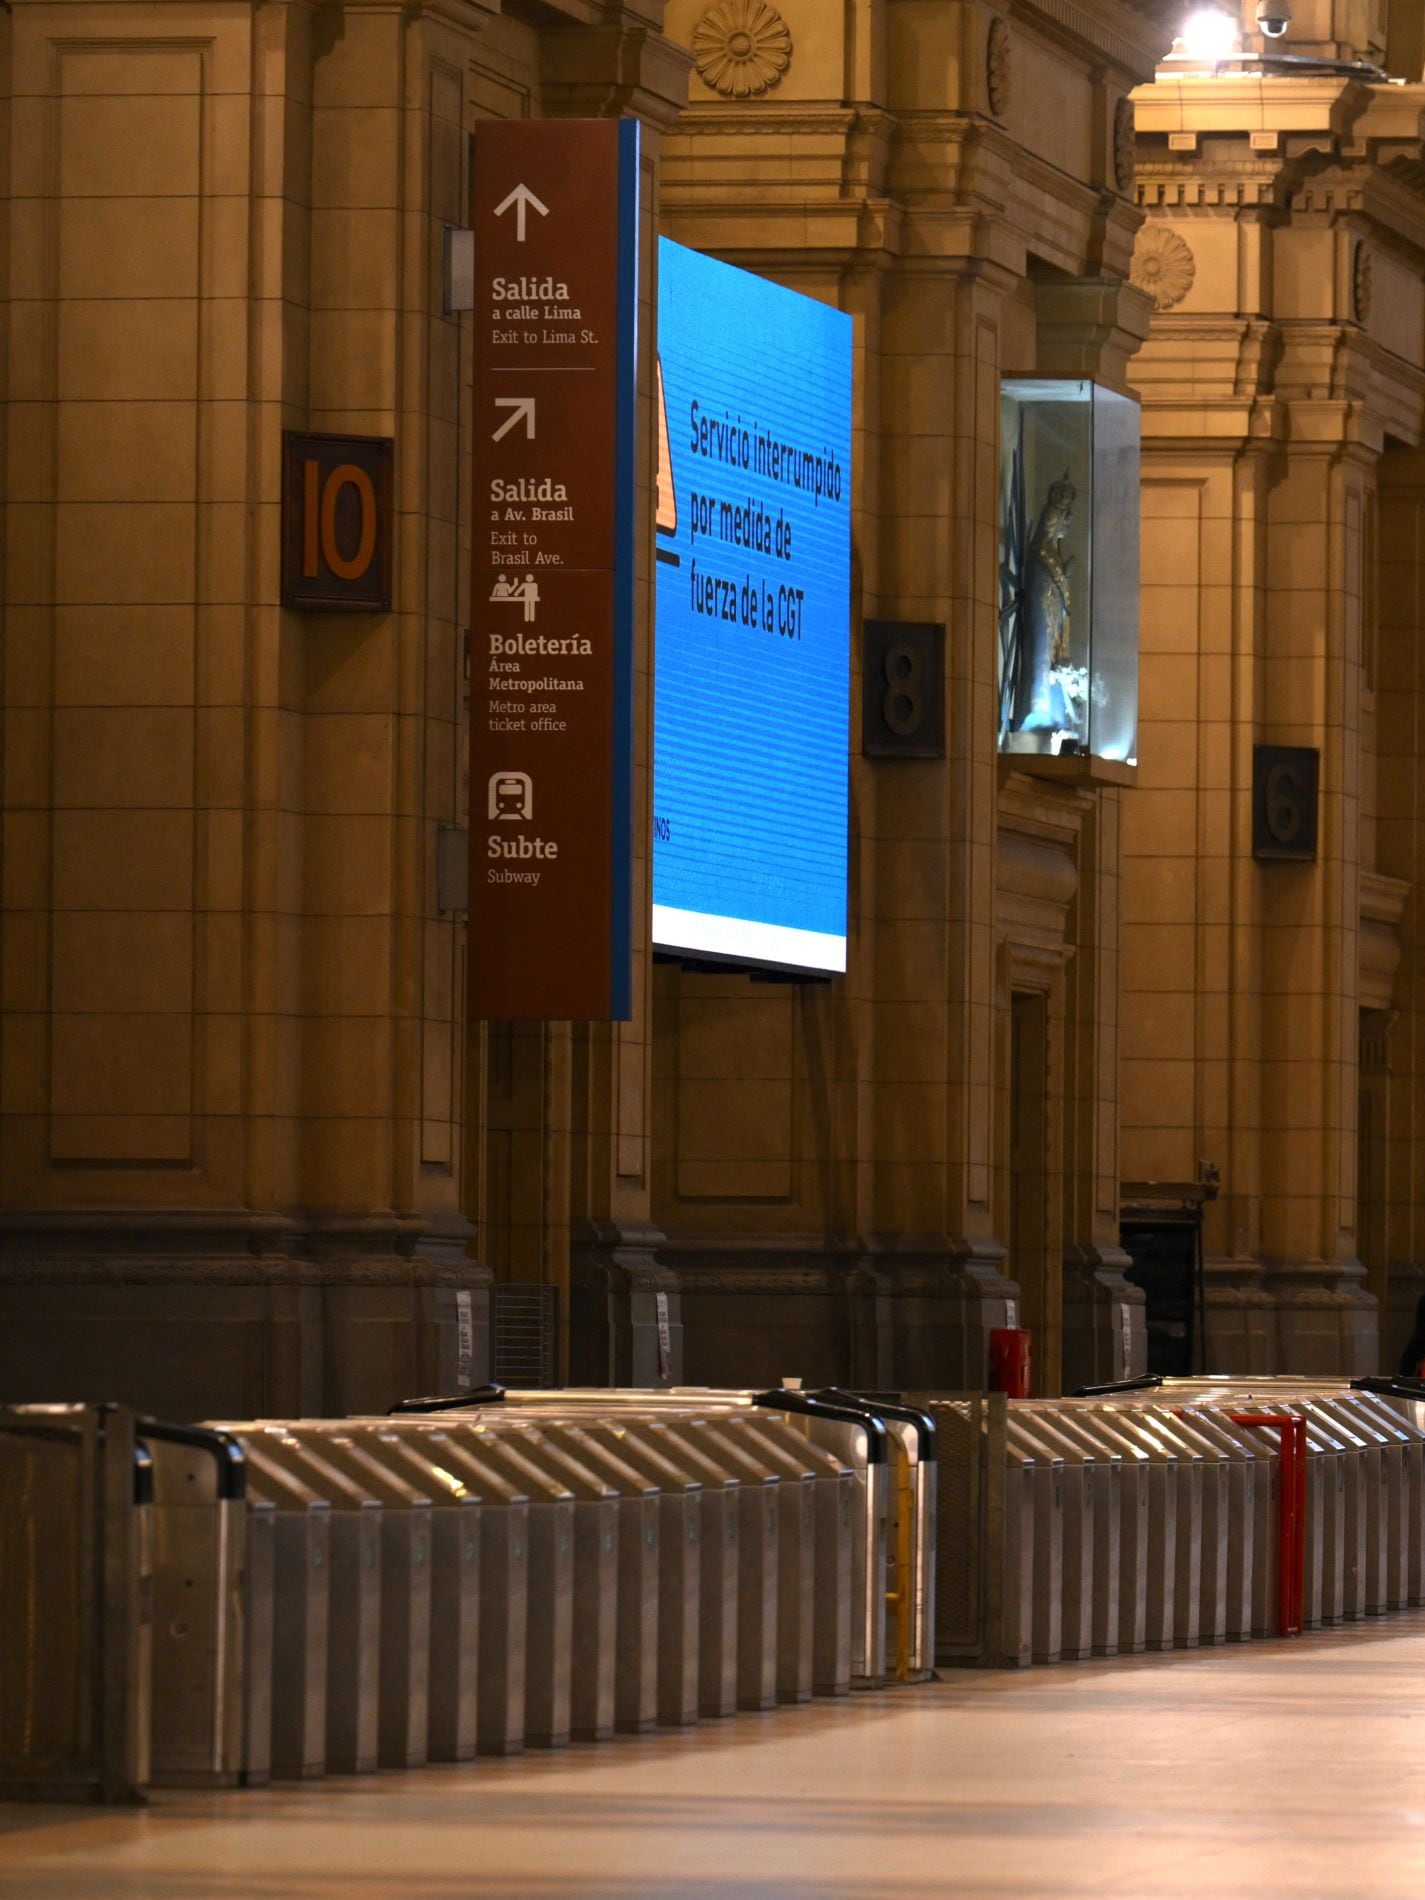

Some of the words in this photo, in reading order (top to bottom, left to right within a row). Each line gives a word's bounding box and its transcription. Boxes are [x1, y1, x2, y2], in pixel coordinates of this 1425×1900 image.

[492, 277, 570, 301] Salida
[492, 308, 501, 320] a
[505, 305, 539, 320] calle
[543, 305, 582, 320] Lima
[492, 329, 519, 344] Exit
[523, 331, 538, 344] to
[542, 329, 576, 344] Lima
[580, 329, 599, 344] St.
[690, 399, 750, 470] Servicio
[753, 420, 842, 508] interrumpido
[490, 478, 568, 502] Salida
[303, 459, 377, 580] 10
[490, 510, 500, 521] a
[504, 507, 526, 521] Av.
[531, 506, 575, 521] Brasil
[690, 491, 716, 546] por
[719, 496, 772, 556] medida
[775, 507, 792, 561] de
[490, 531, 518, 545] Exit
[523, 532, 538, 545] to
[491, 550, 530, 565] Brasil
[534, 551, 564, 565] Ave.
[690, 557, 737, 624] fuerza
[741, 573, 758, 630] de
[762, 578, 774, 634] la
[778, 583, 805, 641] CGT
[488, 632, 593, 655] Boletería
[488, 656, 521, 673] Área
[488, 677, 584, 694] Metropolitana
[488, 700, 526, 713] Metro
[529, 702, 557, 713] area
[488, 717, 526, 731] ticket
[530, 717, 567, 731] office
[487, 835, 558, 859] Subte
[487, 869, 541, 887] Subway
